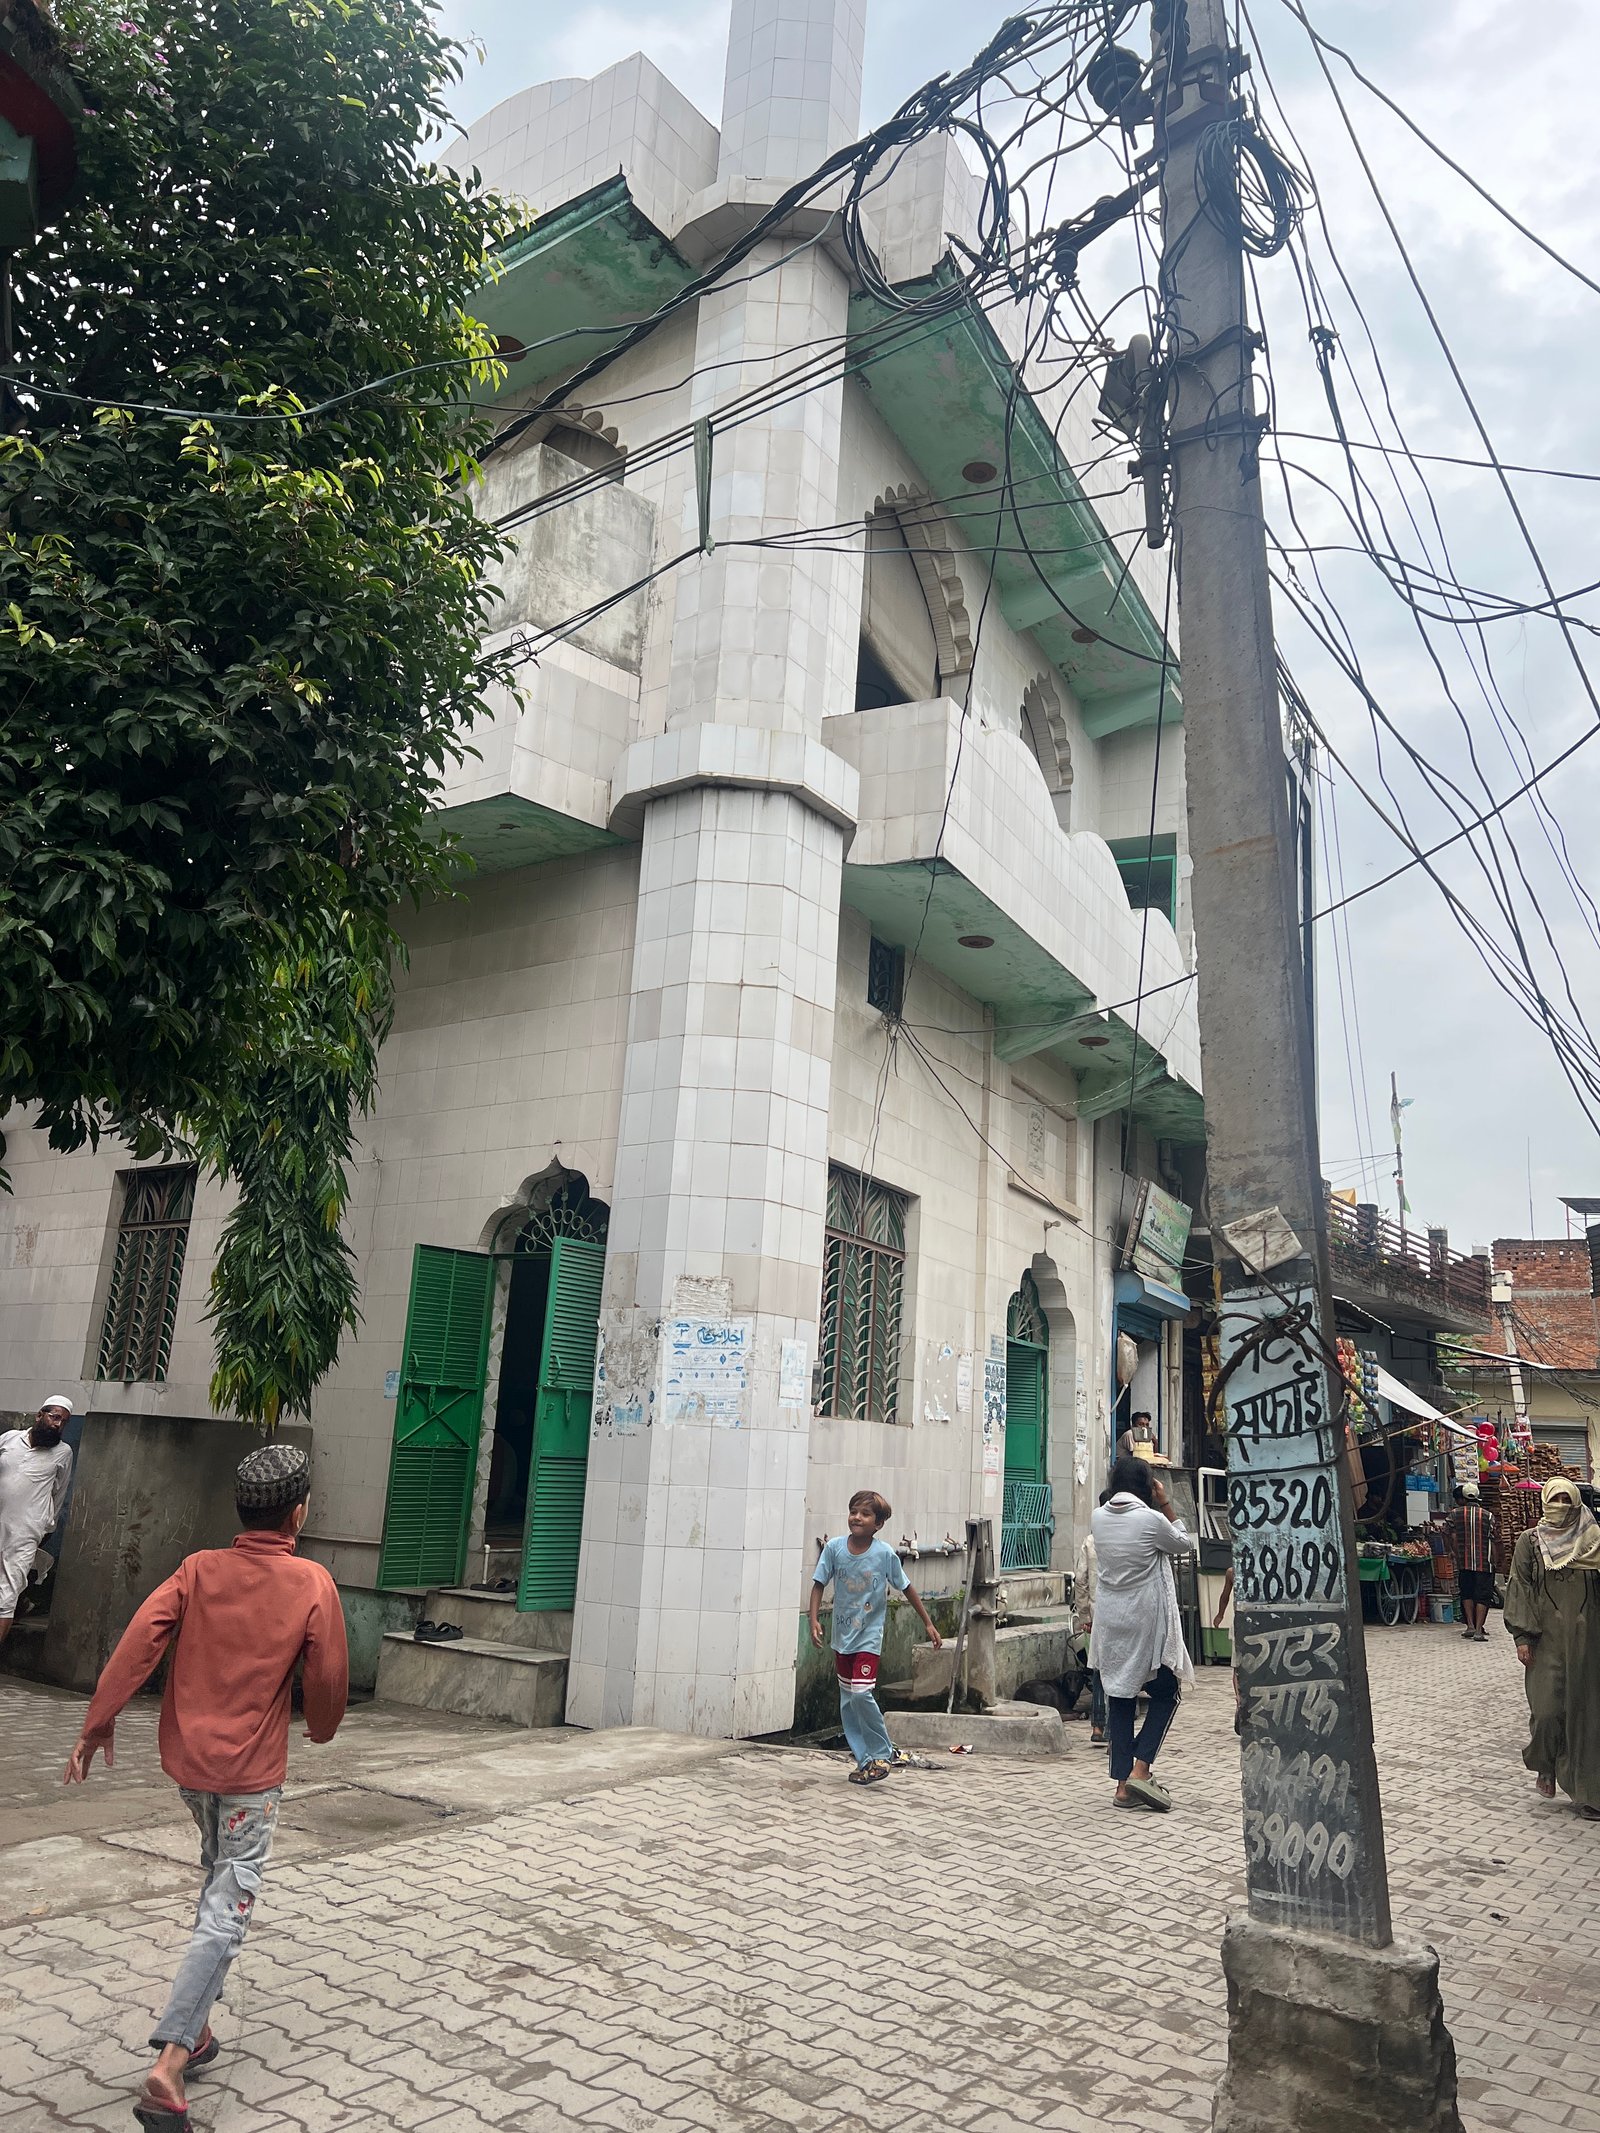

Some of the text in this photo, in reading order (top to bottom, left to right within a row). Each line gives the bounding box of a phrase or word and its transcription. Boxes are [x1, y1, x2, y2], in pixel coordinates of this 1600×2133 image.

[1228, 1360, 1323, 1464] सफाई
[1228, 1475, 1332, 1531] 85320
[1240, 1541, 1339, 1604] 88699
[1241, 1622, 1341, 1676] गटर
[1243, 1810, 1355, 1880] 39090
